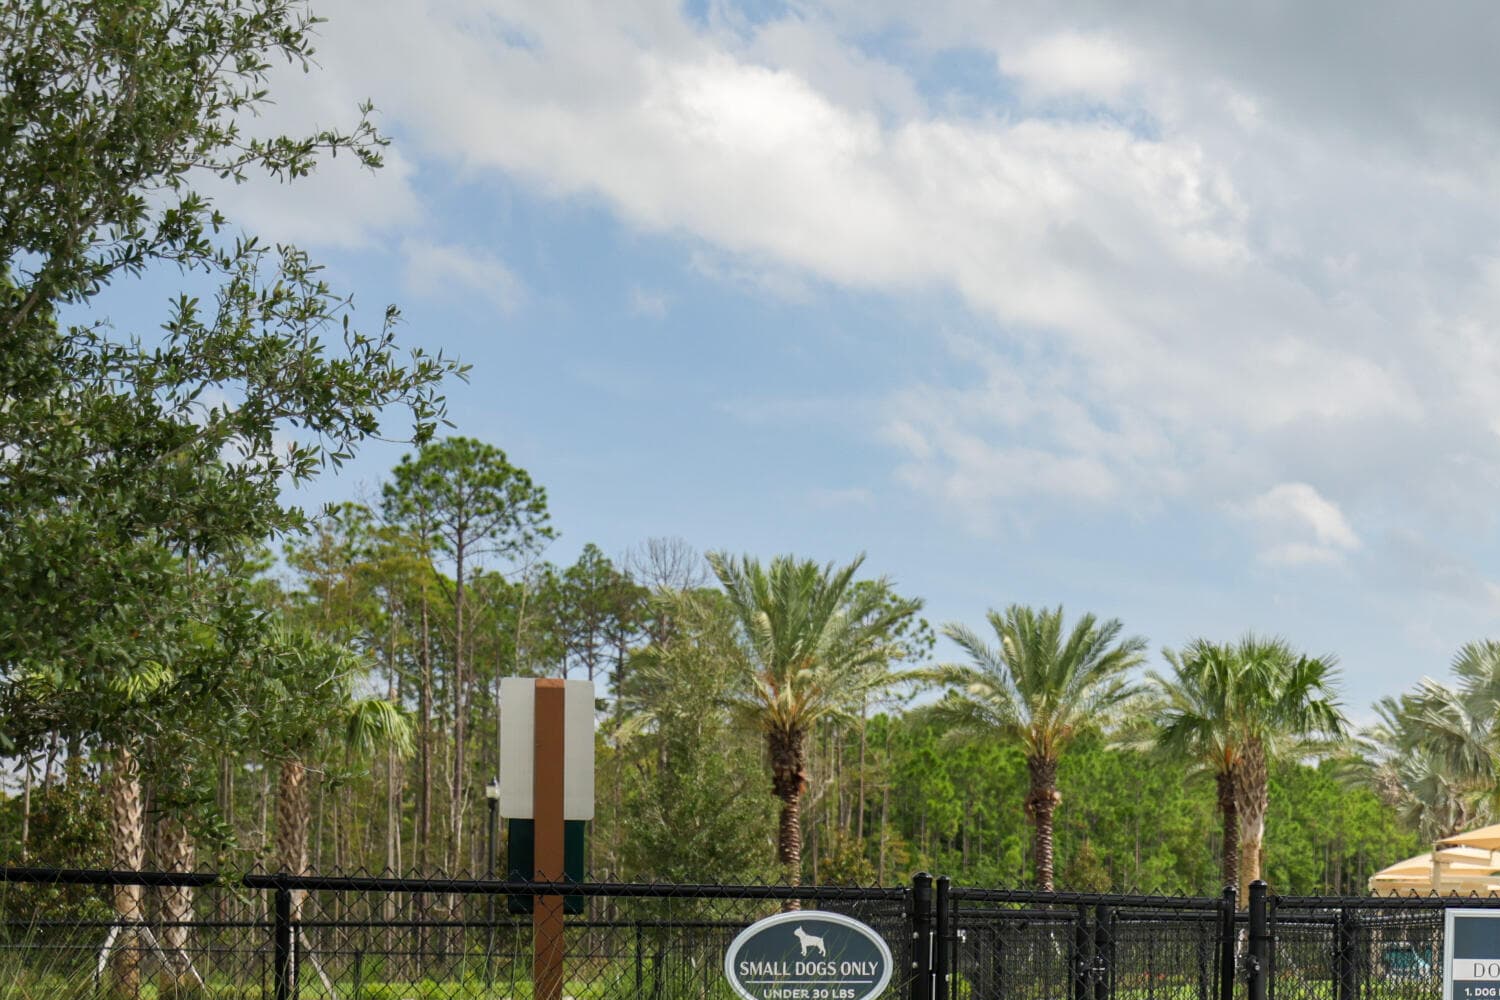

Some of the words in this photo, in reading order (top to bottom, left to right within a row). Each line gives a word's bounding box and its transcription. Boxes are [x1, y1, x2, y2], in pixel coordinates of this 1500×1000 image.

[740, 962, 790, 975] SMALL
[796, 962, 836, 975] DOGS
[841, 962, 878, 976] ONLY
[764, 989, 809, 998] UNDER
[813, 989, 828, 998] 30
[832, 989, 854, 998] LBS
[1475, 988, 1496, 996] DOG
